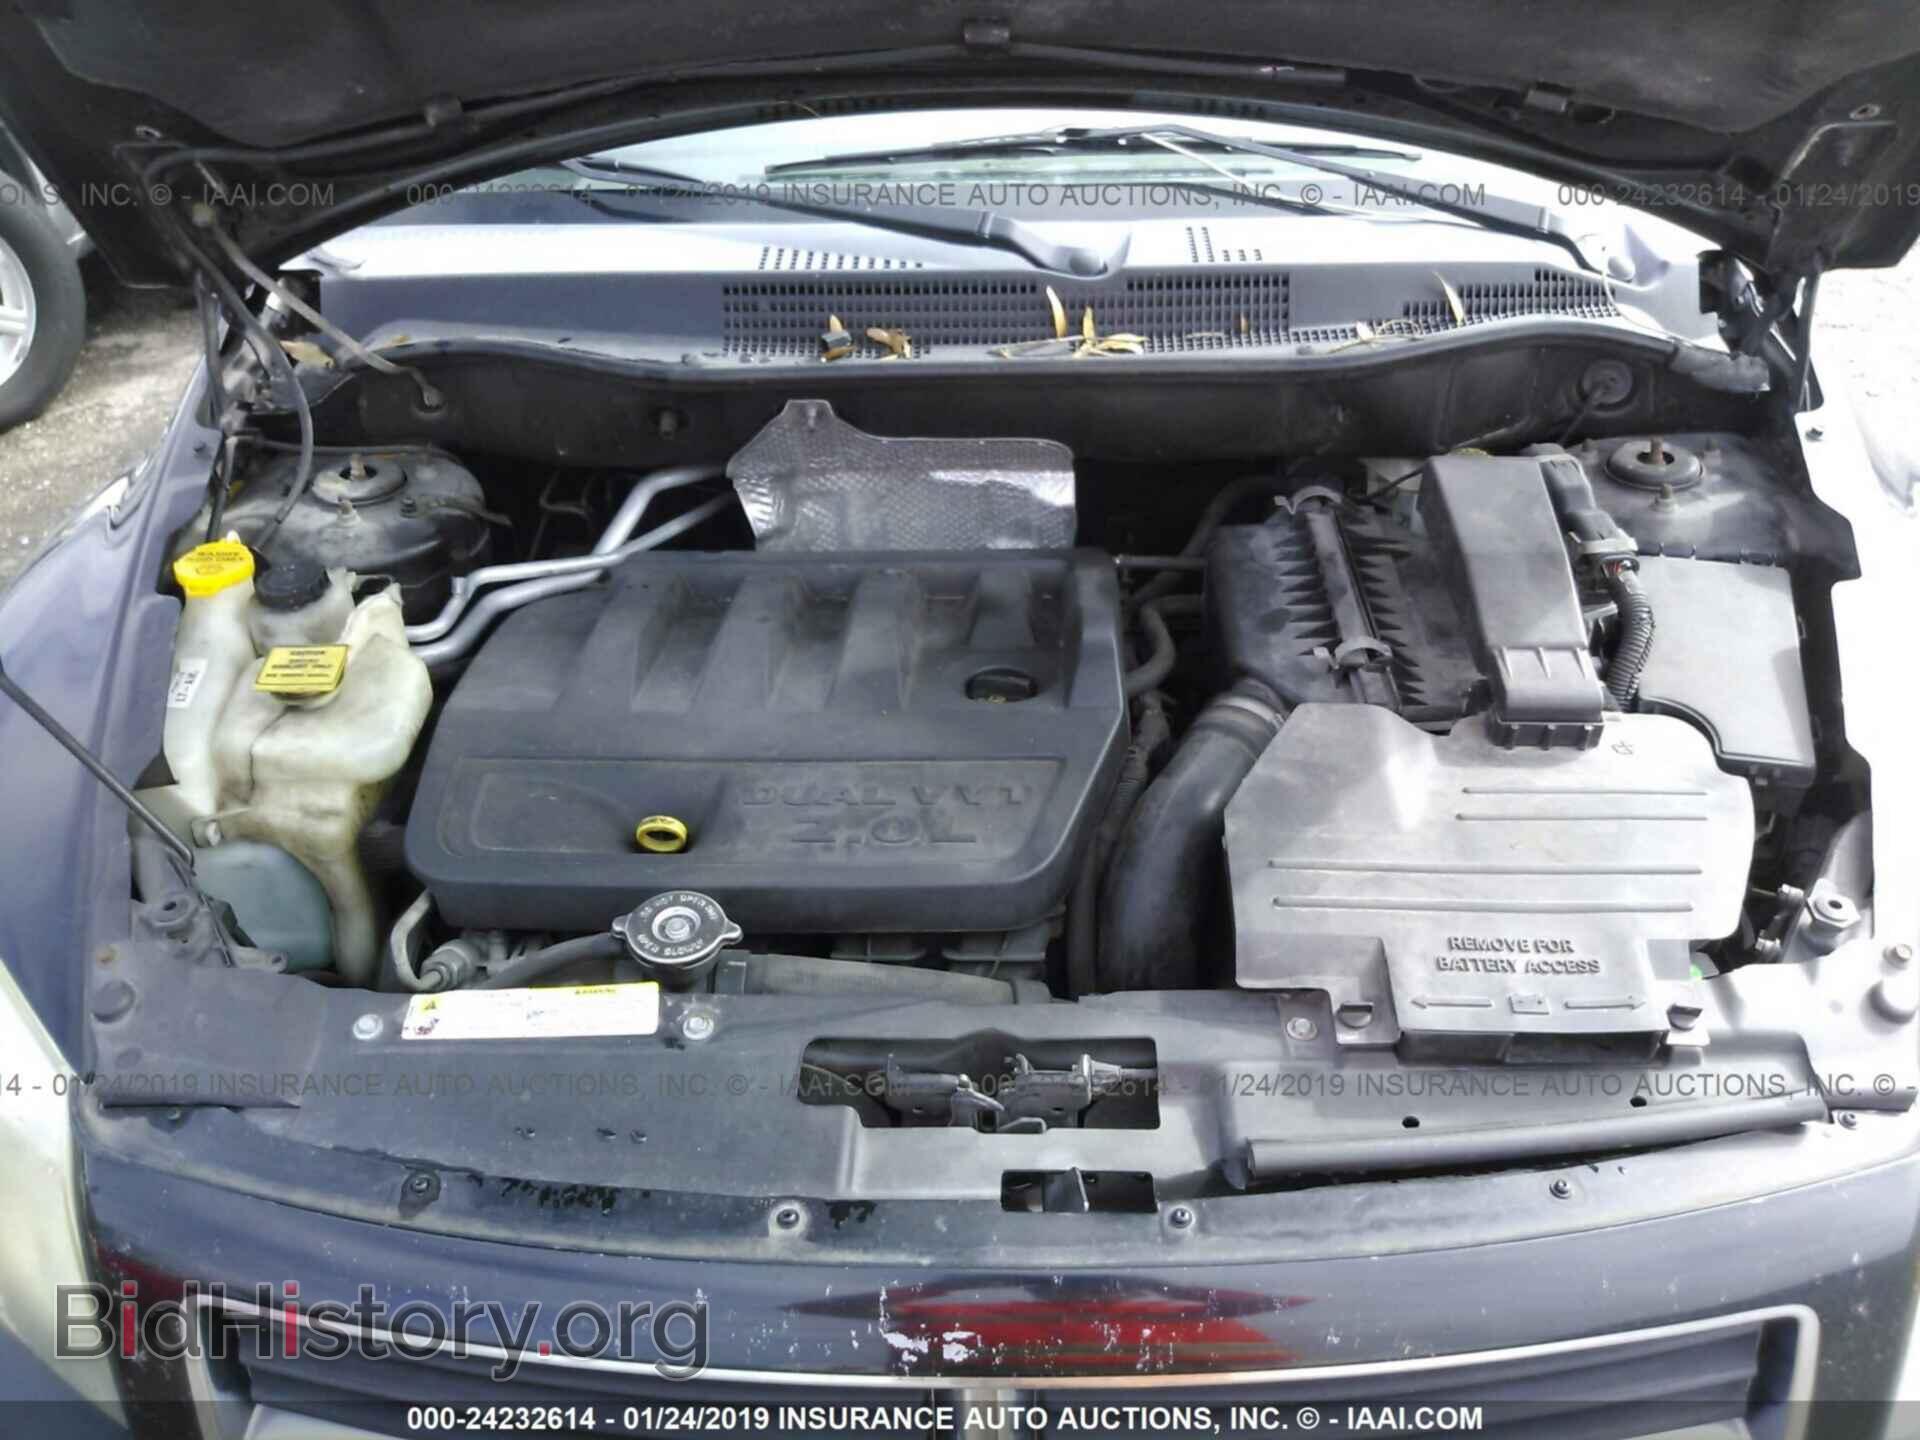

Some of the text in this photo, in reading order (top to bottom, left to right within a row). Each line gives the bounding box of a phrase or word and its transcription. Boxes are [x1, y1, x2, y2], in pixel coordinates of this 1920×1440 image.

[1447, 935, 1575, 954] REMOVE FOR
[1435, 955, 1601, 975] BATTERY ACCESS
